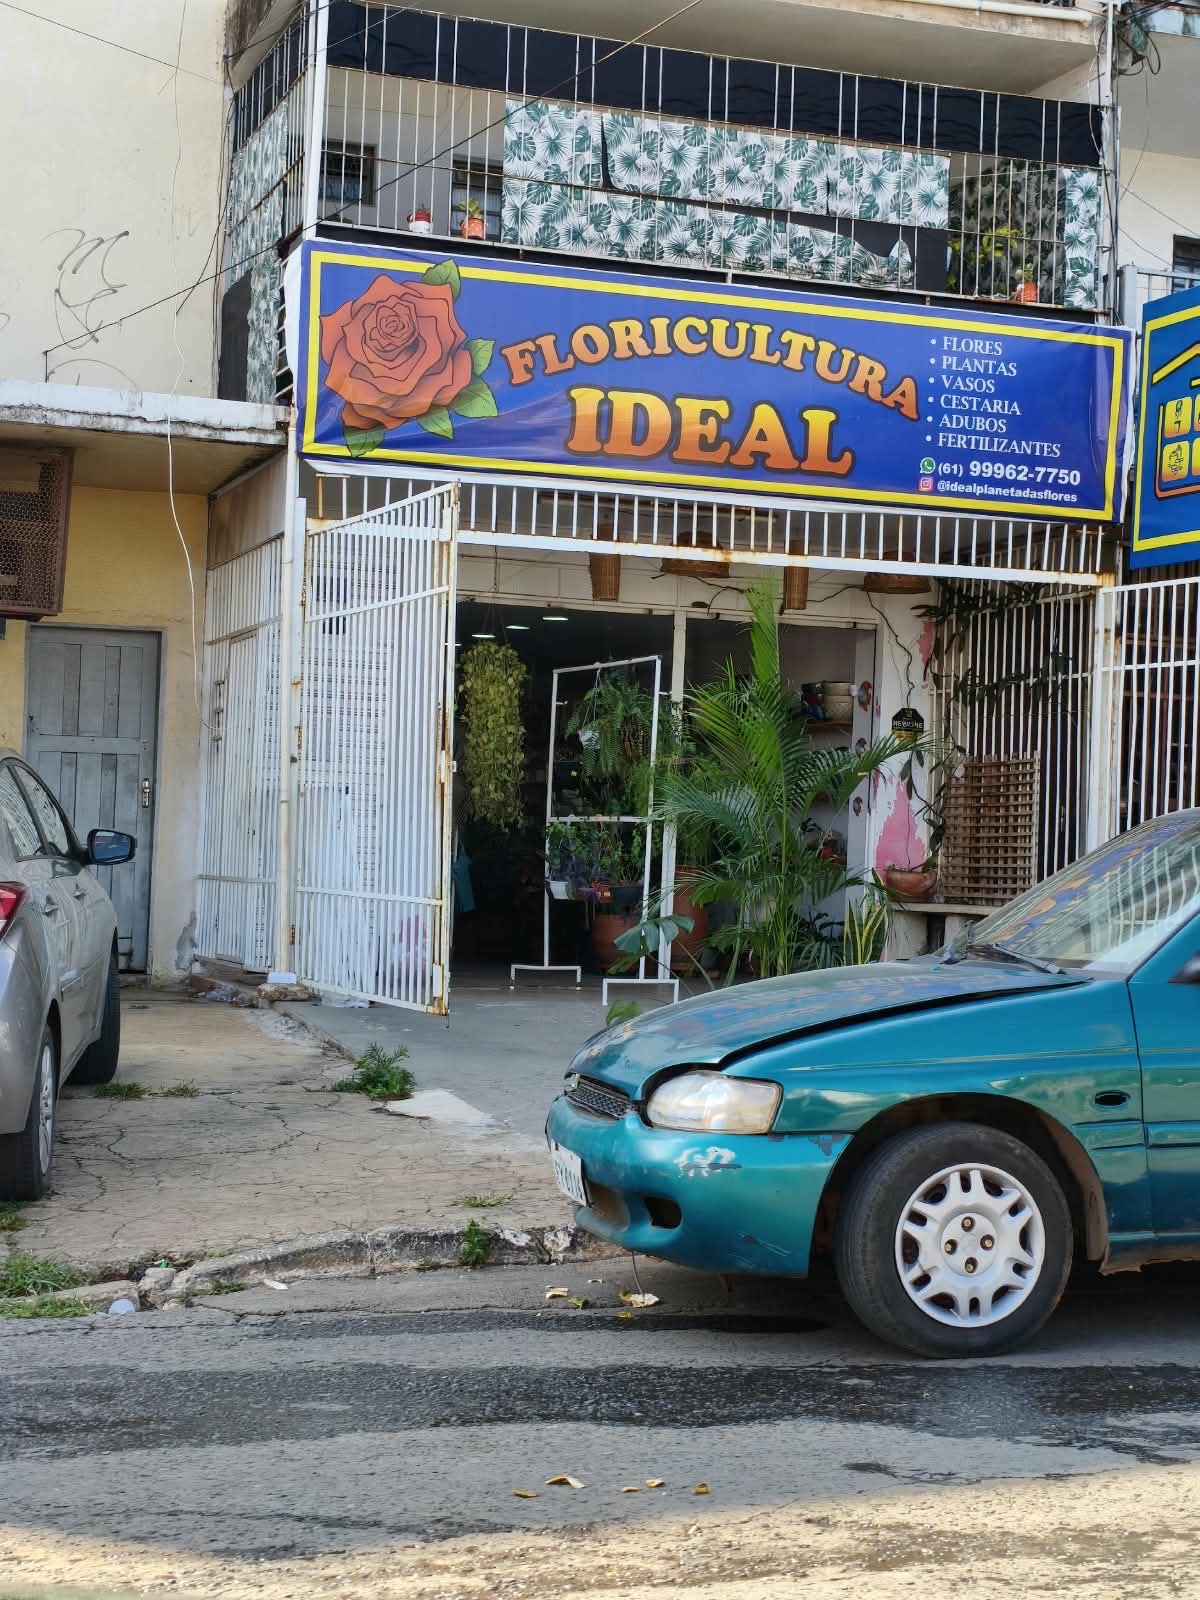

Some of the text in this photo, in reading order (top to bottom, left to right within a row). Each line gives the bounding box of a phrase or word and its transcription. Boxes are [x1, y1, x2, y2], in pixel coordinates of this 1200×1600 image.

[942, 336, 1003, 356] FLORES
[502, 316, 919, 421] FLORICULTURA
[941, 355, 1018, 377] PLANTAS
[940, 374, 996, 394] VASOS
[940, 394, 1022, 416] CESTARIA
[567, 386, 855, 477] IDEAL
[939, 413, 1007, 433] ADUBOS
[937, 432, 1061, 458] FERTILIZANTES
[938, 460, 1082, 486] (61) 99962-7750
[937, 480, 1078, 503] @idealplanetadasflores
